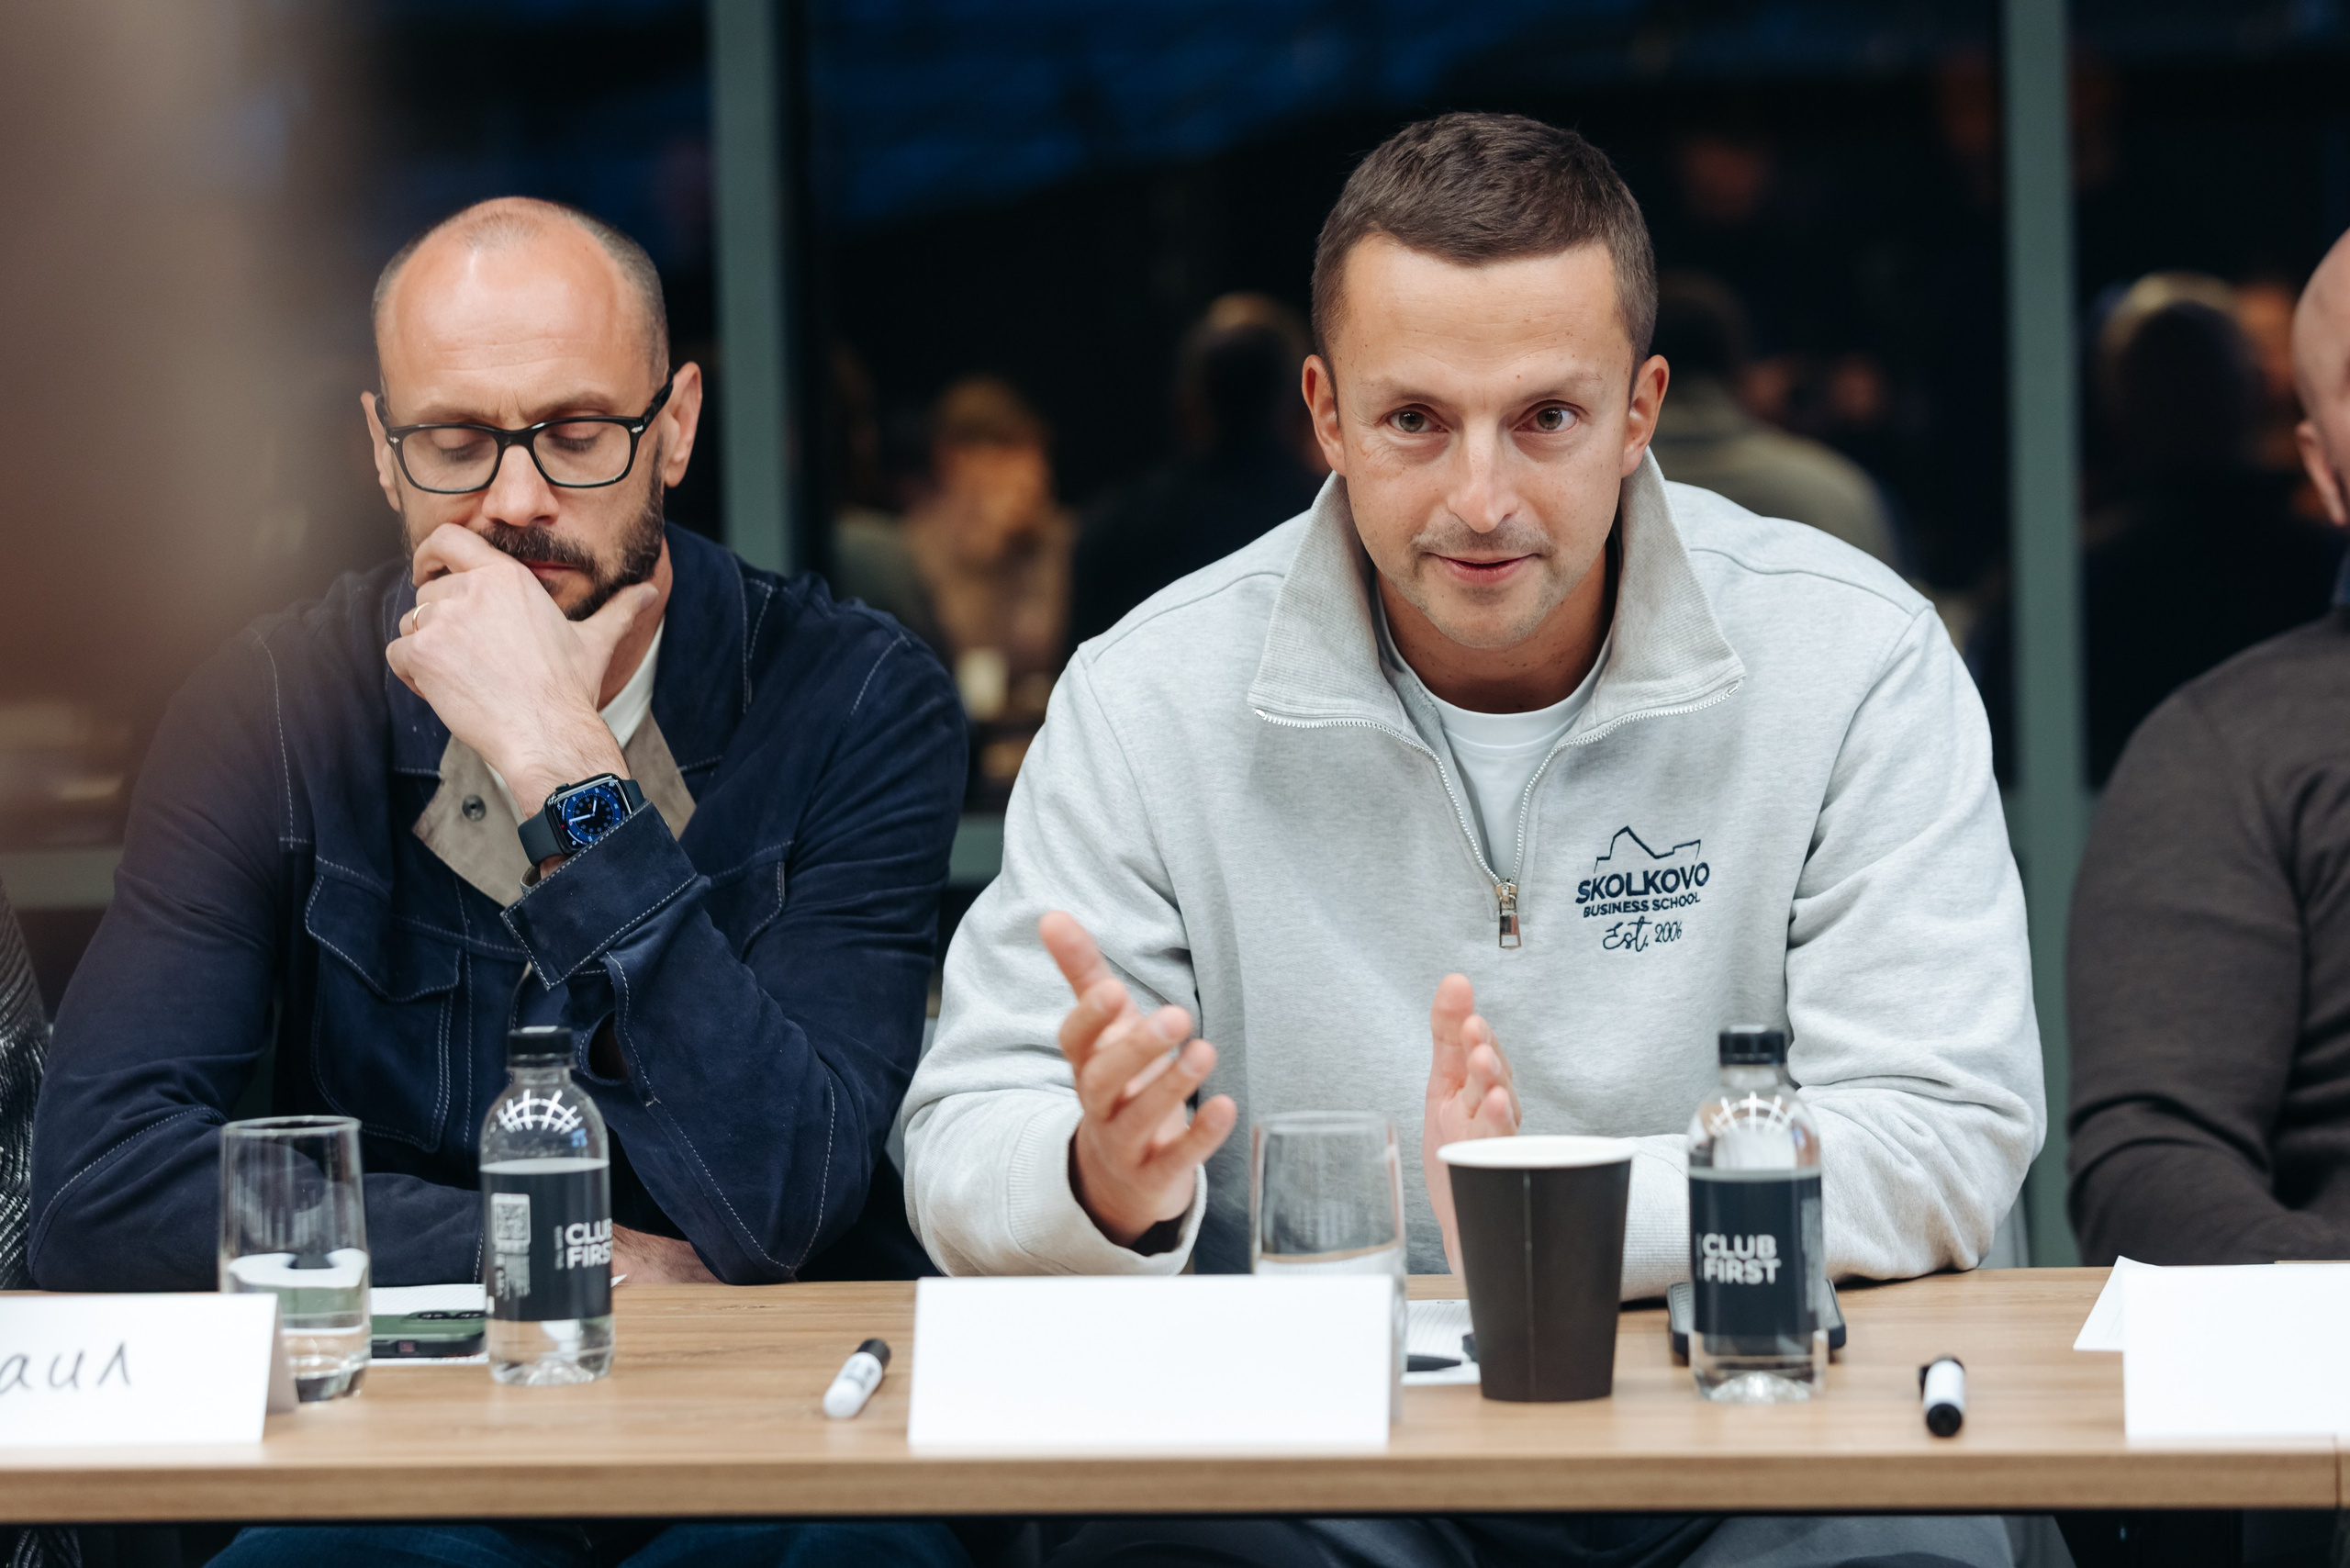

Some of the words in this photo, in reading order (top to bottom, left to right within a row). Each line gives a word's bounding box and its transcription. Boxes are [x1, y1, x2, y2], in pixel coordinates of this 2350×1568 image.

[1575, 862, 1709, 904] SKOLKOVO
[1583, 900, 1650, 918] BUSINESS
[1652, 892, 1701, 911] SCHOOL
[1603, 915, 1652, 952] Est.
[1655, 921, 1683, 943] 2006
[1702, 1233, 1777, 1260] CLUB
[1704, 1258, 1782, 1284] FIRST
